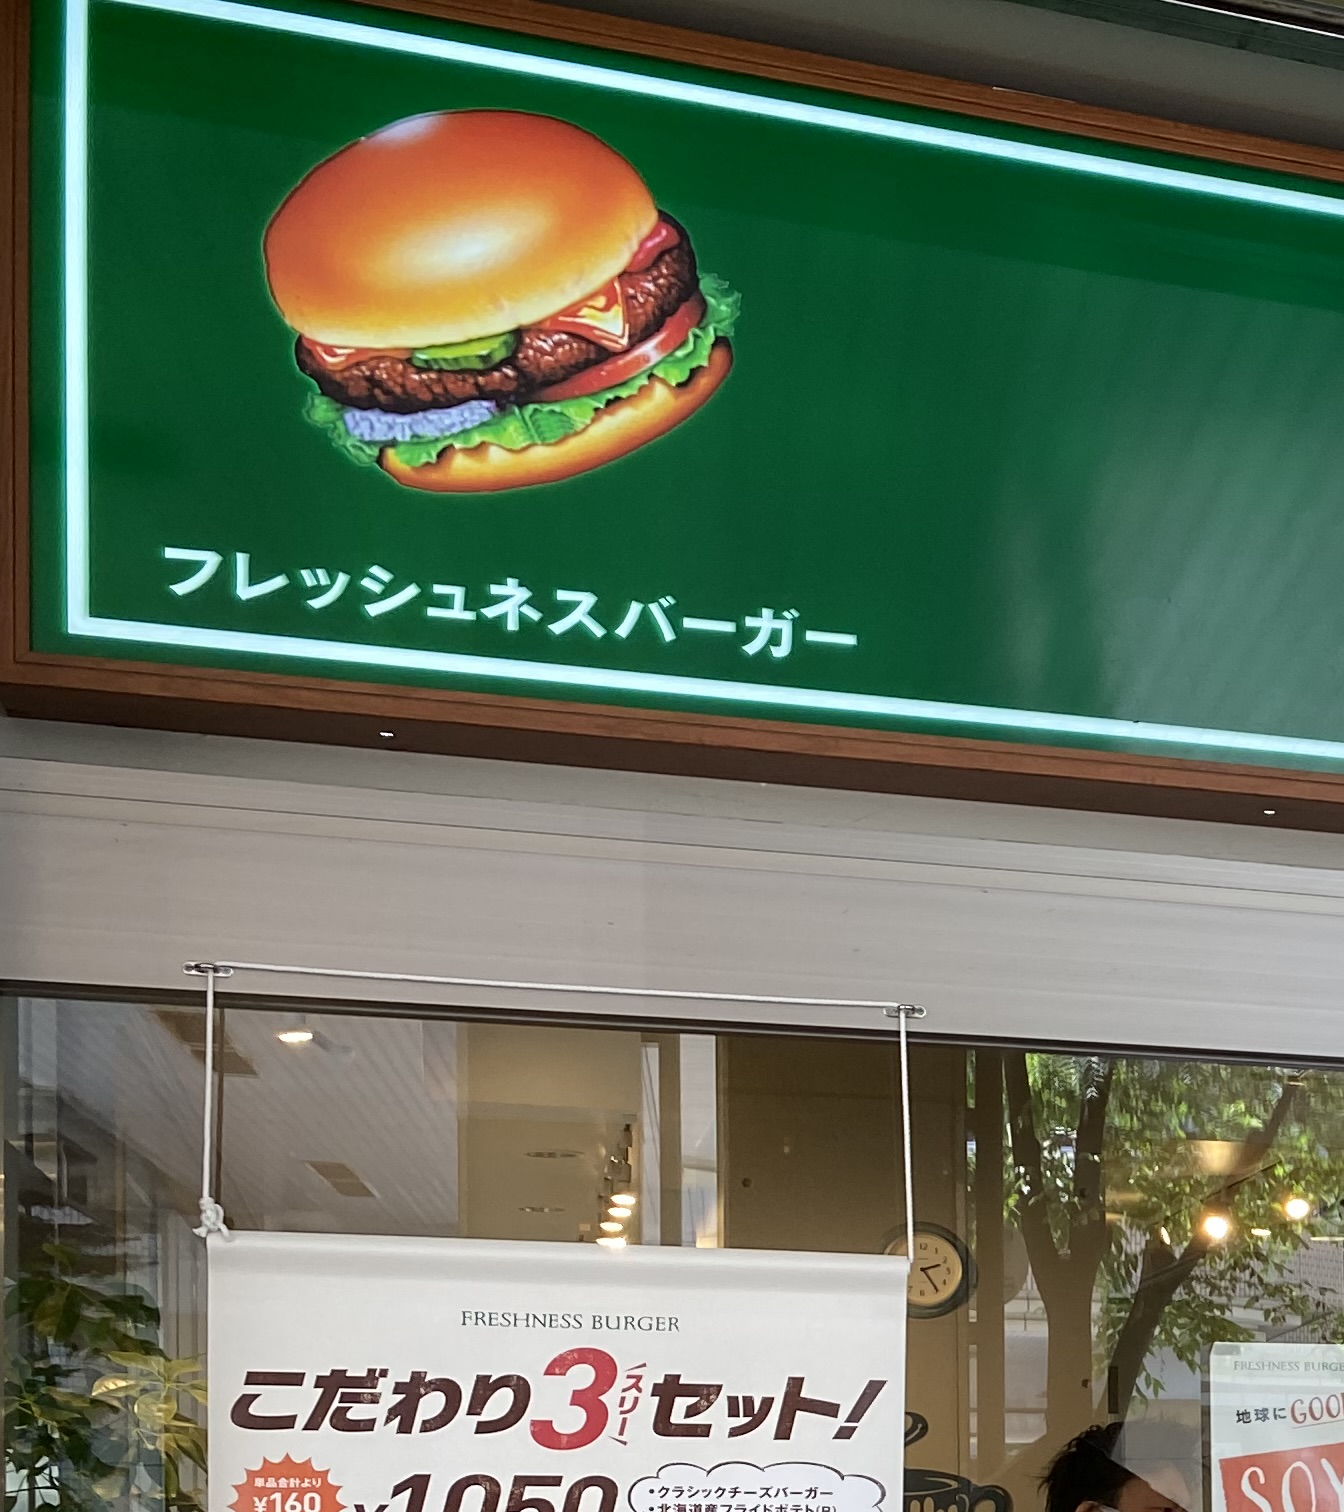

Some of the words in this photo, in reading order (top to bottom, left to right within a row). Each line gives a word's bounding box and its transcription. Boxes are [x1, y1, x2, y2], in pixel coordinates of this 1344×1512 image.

[161, 545, 859, 661] フレッシュネスバーガー
[460, 1310, 584, 1330] FRESHNESS
[590, 1312, 680, 1332] BURGER
[1233, 1360, 1301, 1371] FRESHNESS
[254, 1477, 321, 1488] 単品合計より
